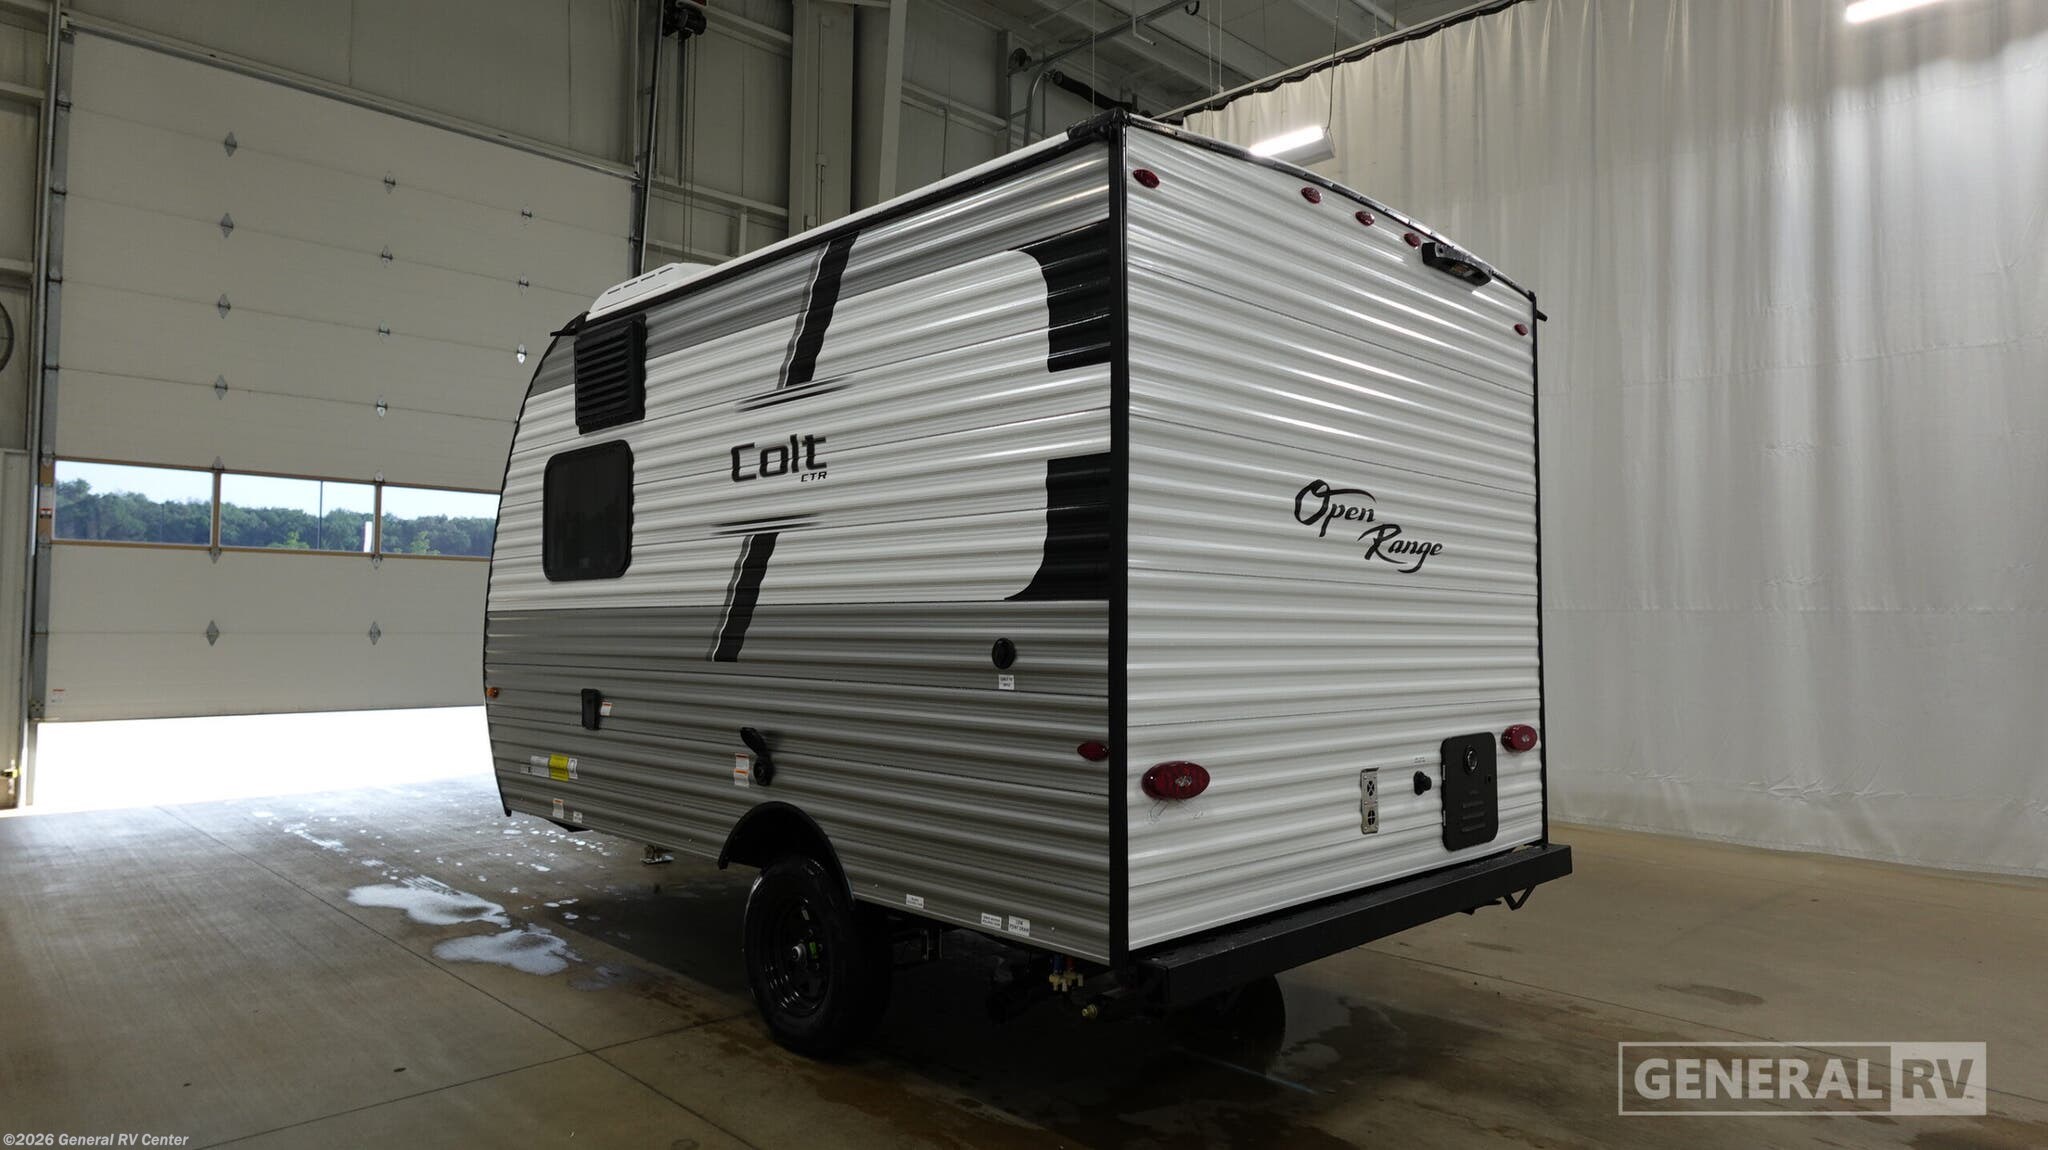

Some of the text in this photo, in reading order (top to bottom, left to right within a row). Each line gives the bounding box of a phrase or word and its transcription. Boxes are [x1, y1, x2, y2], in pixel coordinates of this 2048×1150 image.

[730, 433, 828, 483] Colt
[800, 471, 828, 483] CTR
[1294, 479, 1377, 538] Open
[1357, 523, 1443, 574] Range
